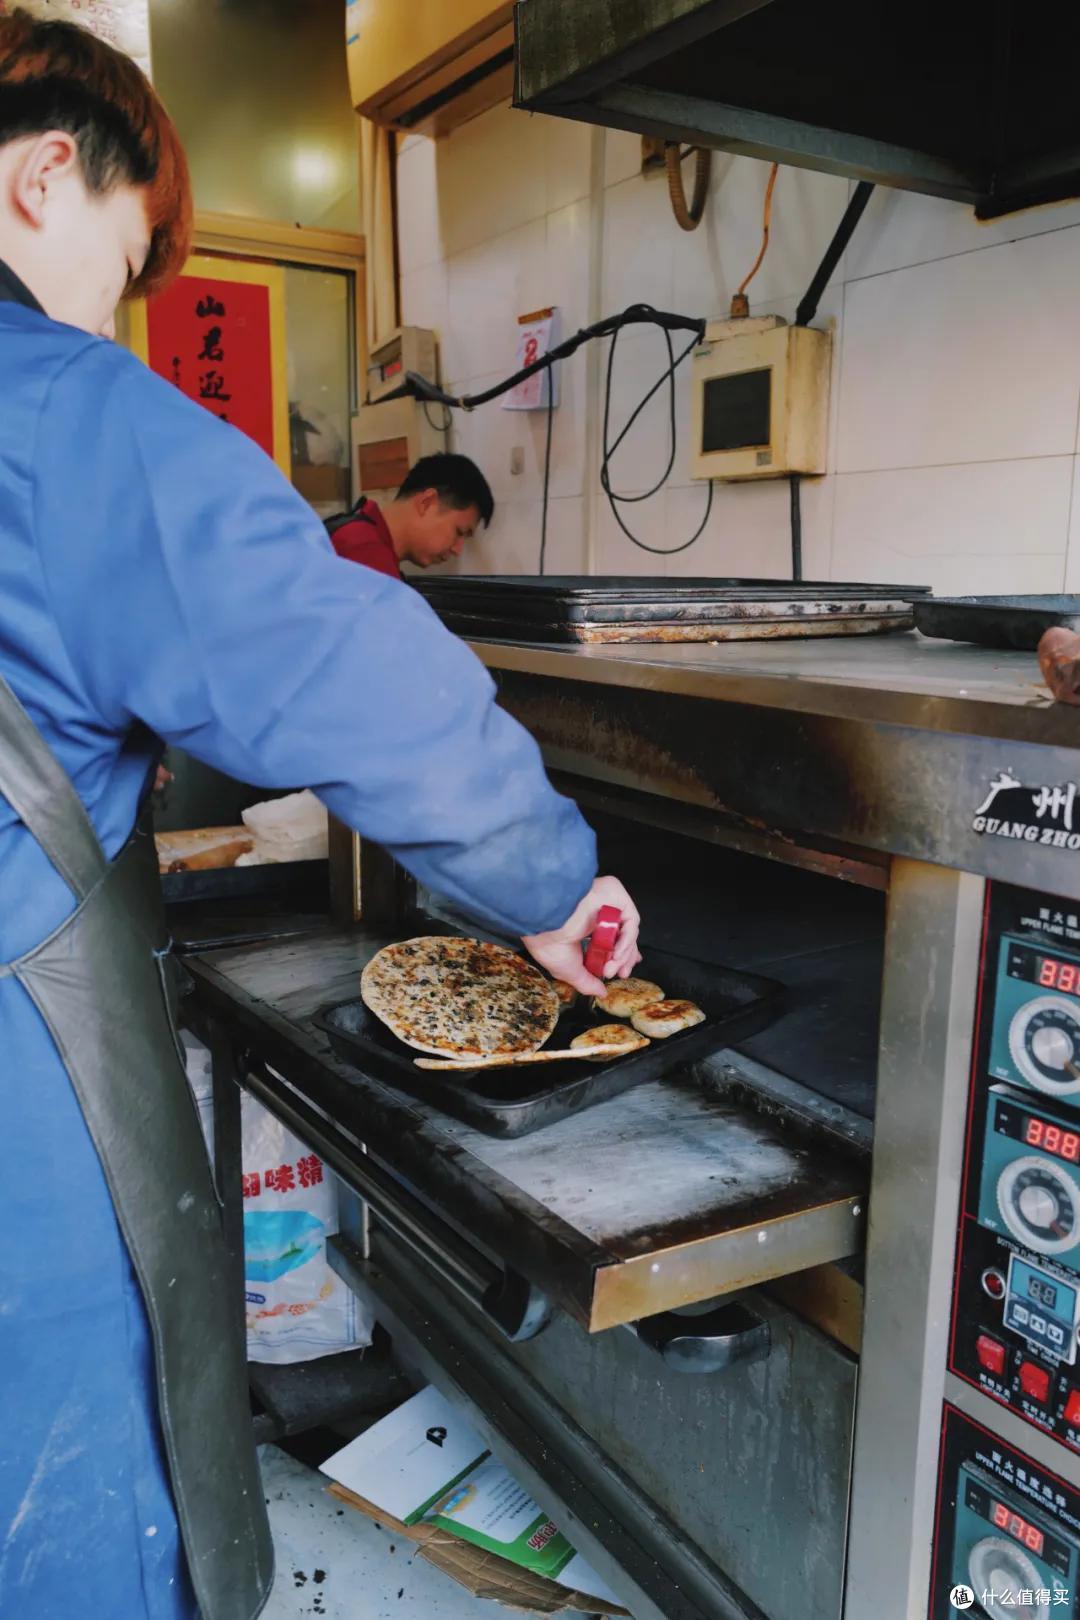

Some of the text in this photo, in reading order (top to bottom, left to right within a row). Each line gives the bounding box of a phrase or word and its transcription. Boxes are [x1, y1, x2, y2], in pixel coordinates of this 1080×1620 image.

[196, 295, 231, 422] 山君迎
[975, 768, 1077, 831] 广州
